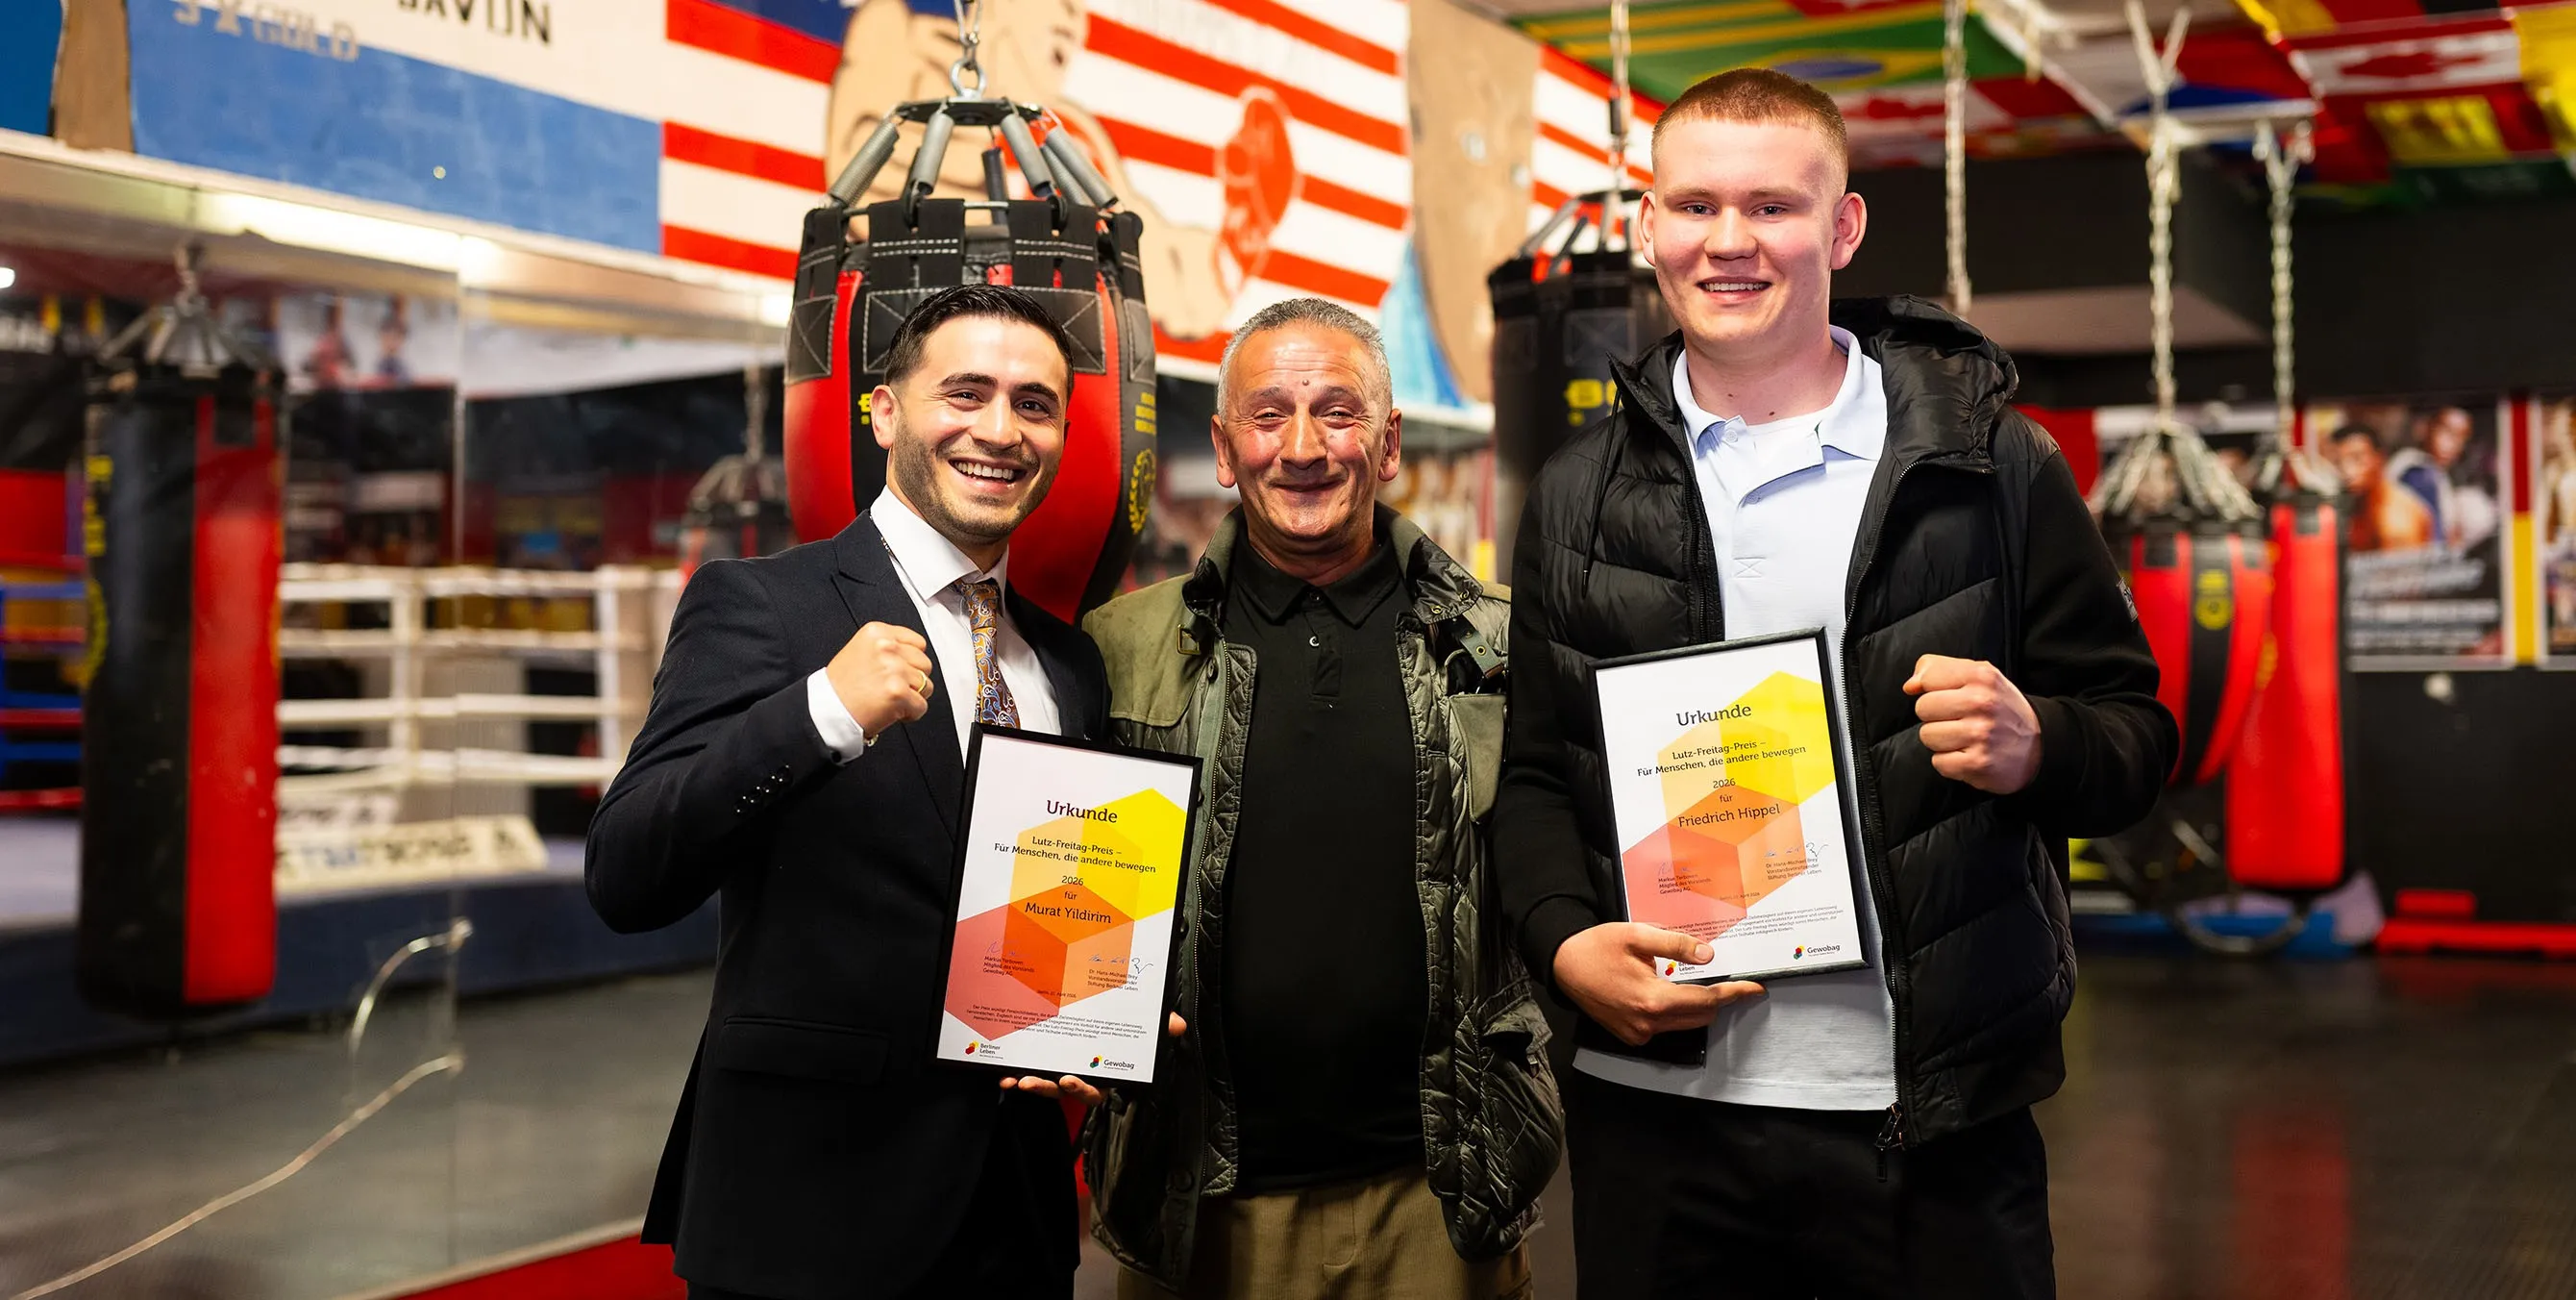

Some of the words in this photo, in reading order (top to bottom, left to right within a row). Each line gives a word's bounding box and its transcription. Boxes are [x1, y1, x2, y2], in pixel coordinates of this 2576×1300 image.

[1676, 704, 1752, 727] Urkunde
[1672, 739, 1757, 760] Lutz-Freitag-Preis
[1637, 767, 1652, 777] Für
[1655, 762, 1706, 775] Menschen,
[1709, 758, 1723, 766] die
[1726, 754, 1760, 764] andere
[1762, 746, 1807, 759] bewegen
[1713, 778, 1736, 789] 2026
[1720, 793, 1733, 803] für
[1047, 800, 1118, 823] Urkunde
[1678, 810, 1735, 828] Friedrich
[1738, 804, 1781, 820] Hippel
[1032, 837, 1114, 856] Lutz-Freitag-Preis
[994, 843, 1009, 853] Für
[1011, 846, 1061, 861] Menschen,
[1064, 853, 1078, 862] die
[1080, 857, 1113, 866] andere
[1115, 860, 1156, 873] bewegen
[1061, 876, 1084, 886] 2026
[1064, 890, 1077, 901] für
[1025, 902, 1060, 917] Murat
[1065, 907, 1111, 923] Yildirim
[1807, 944, 1841, 954] Gewobag
[1103, 1059, 1135, 1069] Gewobag
